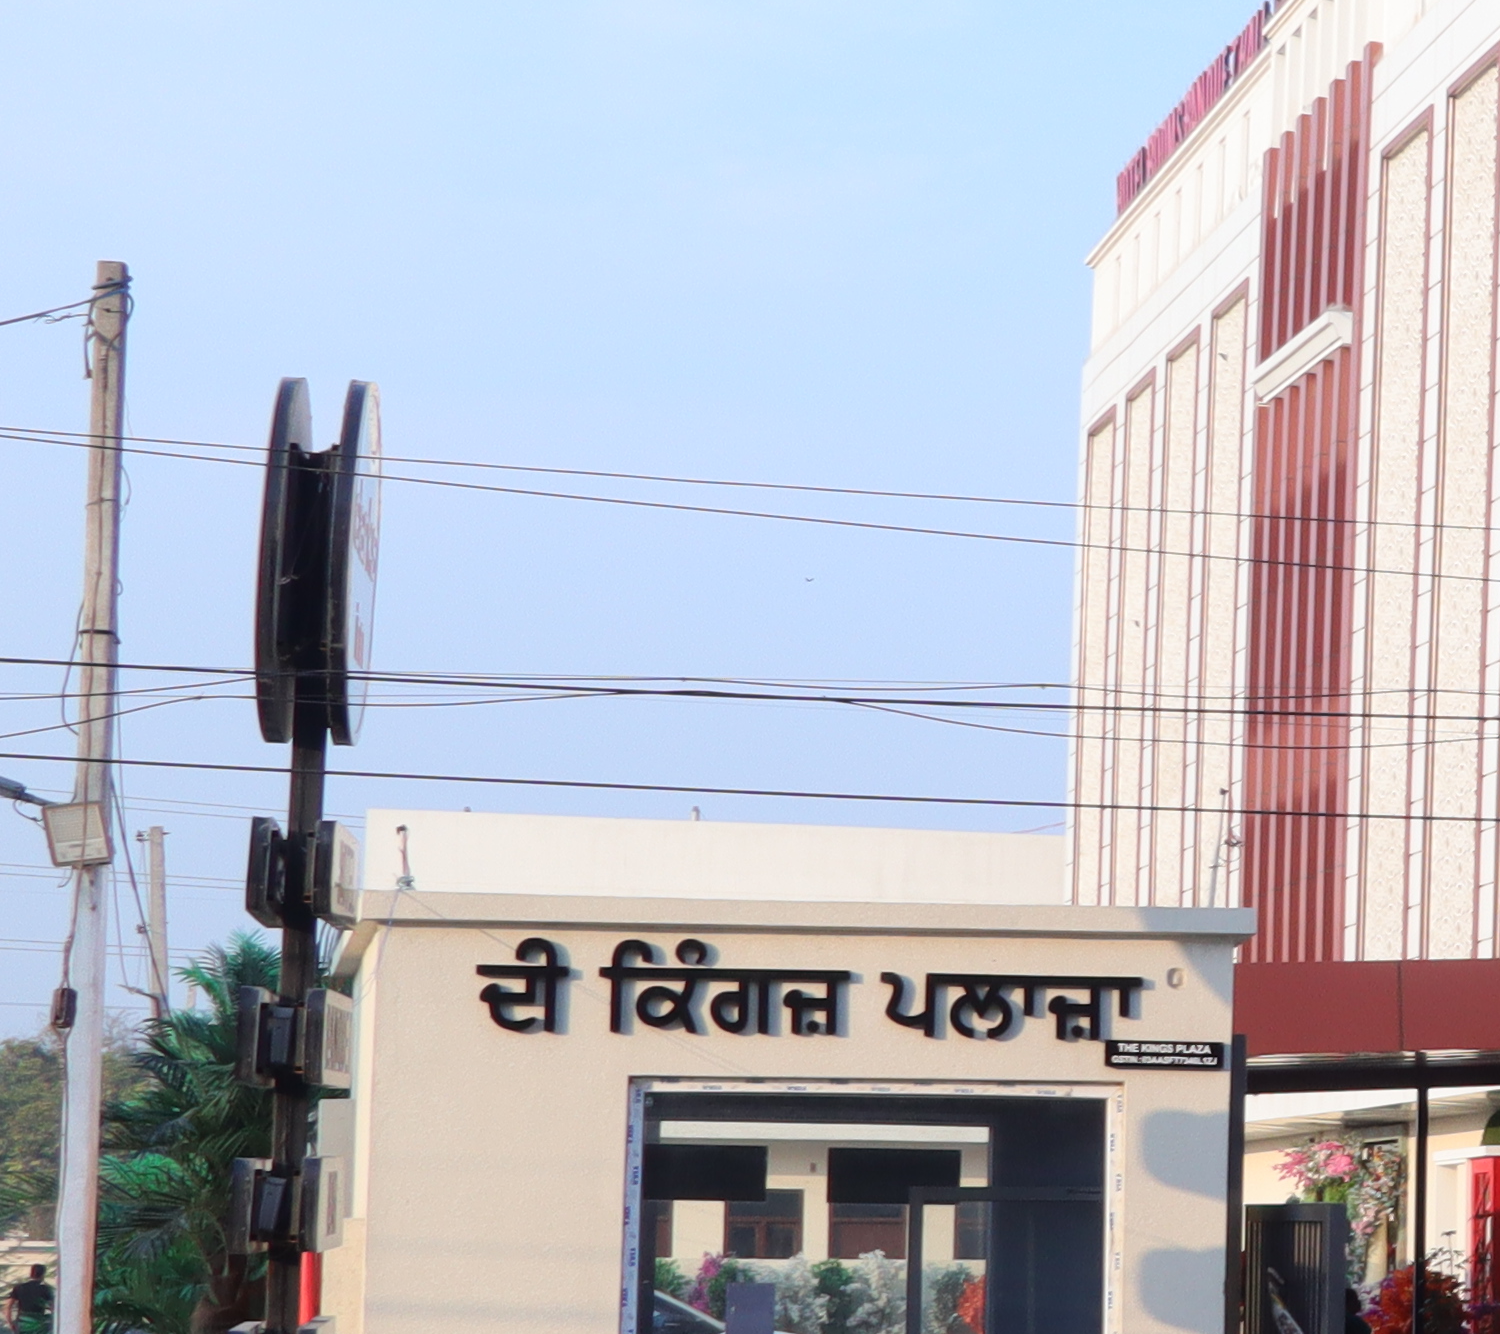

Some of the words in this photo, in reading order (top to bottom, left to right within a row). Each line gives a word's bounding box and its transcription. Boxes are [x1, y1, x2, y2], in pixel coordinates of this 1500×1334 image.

[476, 937, 570, 1034] ਦੀ
[1117, 1043, 1140, 1053] THE
[1140, 1043, 1174, 1054] KINGS
[1175, 1043, 1211, 1054] PLAZA
